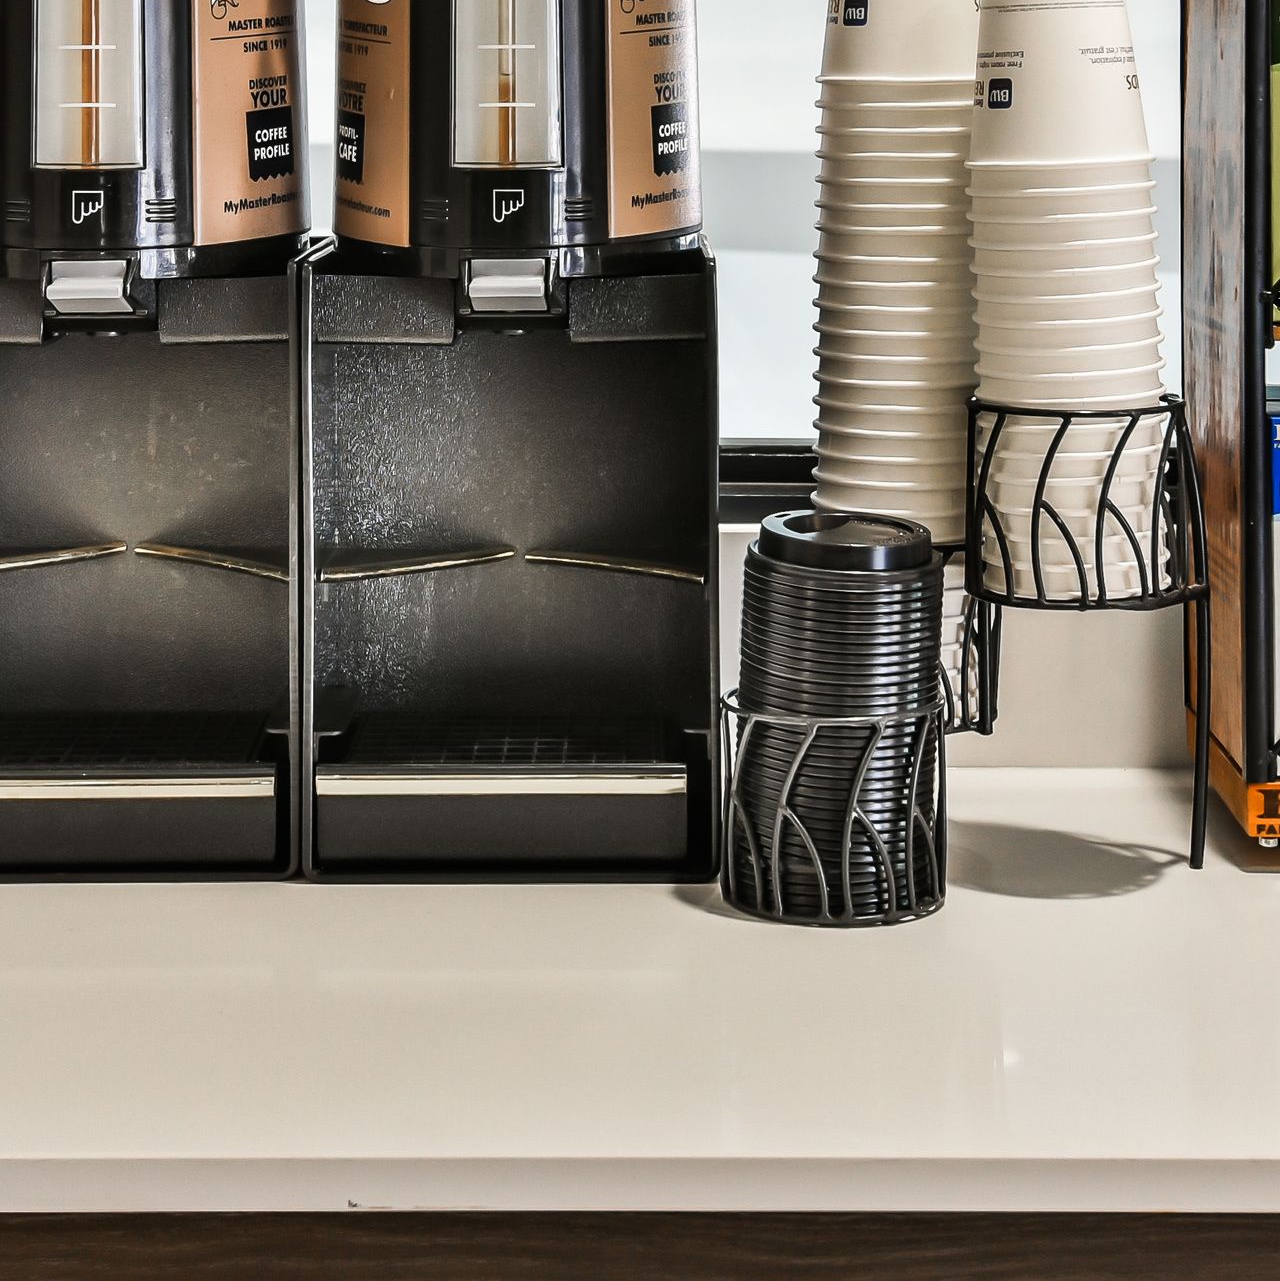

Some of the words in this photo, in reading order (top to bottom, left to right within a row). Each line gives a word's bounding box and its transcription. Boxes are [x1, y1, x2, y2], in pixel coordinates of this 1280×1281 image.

[636, 12, 667, 25] MASTER
[845, 7, 865, 20] BW
[229, 18, 262, 31] MASTER
[244, 40, 267, 52] SINCE
[271, 38, 287, 50] 1919
[649, 35, 669, 46] SINCE
[354, 43, 369, 57] 1919
[249, 75, 287, 89] DISCOVER
[251, 88, 287, 108] YOUR
[655, 85, 686, 103] YOUR
[990, 89, 1009, 102] BW
[256, 127, 287, 142] COFFEE
[659, 122, 686, 137] COFFEE
[255, 144, 289, 160] PROFILE
[339, 140, 357, 162] CAFÉ
[658, 138, 688, 155] PROFILE
